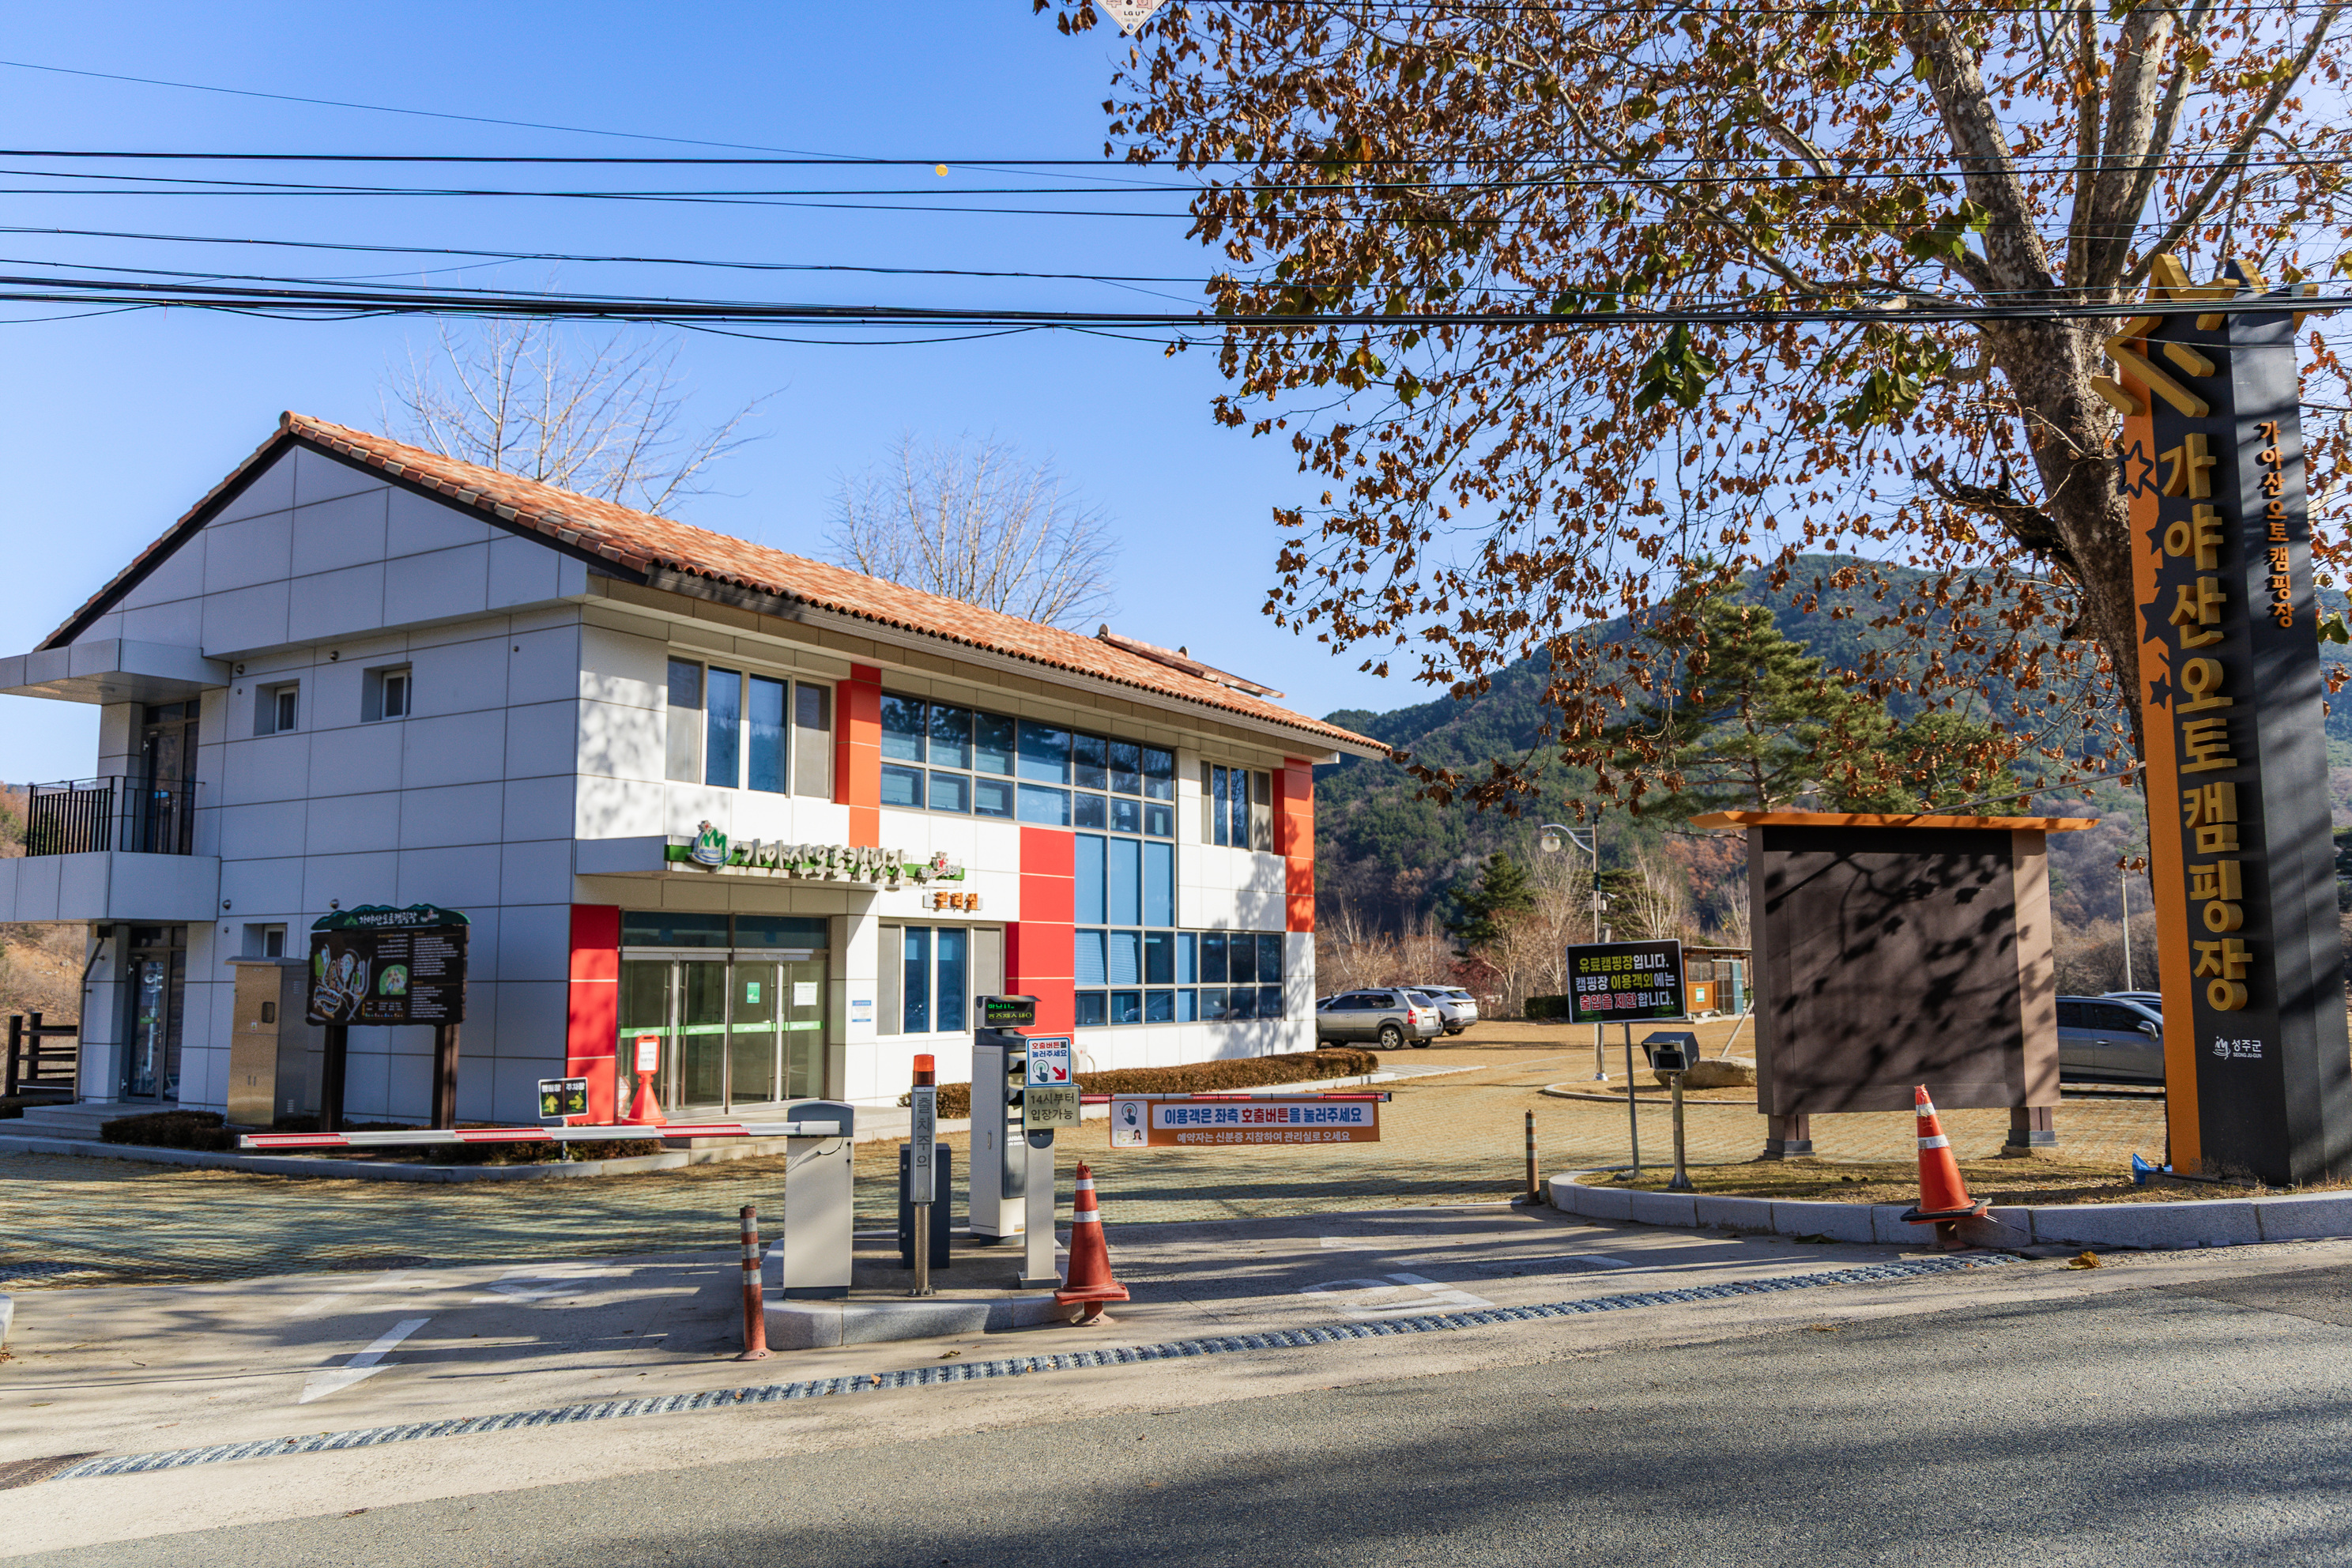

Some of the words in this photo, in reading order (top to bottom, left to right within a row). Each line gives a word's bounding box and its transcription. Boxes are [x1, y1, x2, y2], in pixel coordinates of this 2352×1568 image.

[2260, 420, 2294, 628] 가야산오토캠핑장
[2160, 433, 2252, 1011] 가야산오토캠핑장
[935, 891, 978, 910] 관리실
[1579, 953, 1669, 973] 유료캠핑장입니다.
[1575, 975, 1608, 992] 캠핑장
[1611, 972, 1675, 989] 이용객외에는
[1579, 993, 1613, 1011] 출입을
[1615, 991, 1674, 1009] 제한합니다.
[1031, 1041, 1067, 1050] 호출버튼을
[2232, 1039, 2261, 1052] 성주군
[1031, 1092, 1074, 1104] 14시부터
[1031, 1109, 1073, 1121] 입장가능
[1164, 1108, 1212, 1124] 이용객은
[1215, 1108, 1238, 1123] 좌측
[1242, 1108, 1300, 1123] 호출버튼을
[1303, 1107, 1362, 1122] 눌러주세요
[917, 1097, 931, 1169] 출차주의
[1177, 1132, 1214, 1143] 예약자는
[1216, 1132, 1243, 1143] 신분증
[1246, 1131, 1282, 1142] 지참하여
[1284, 1131, 1321, 1142] 관리실로
[1323, 1131, 1350, 1141] 오세요
